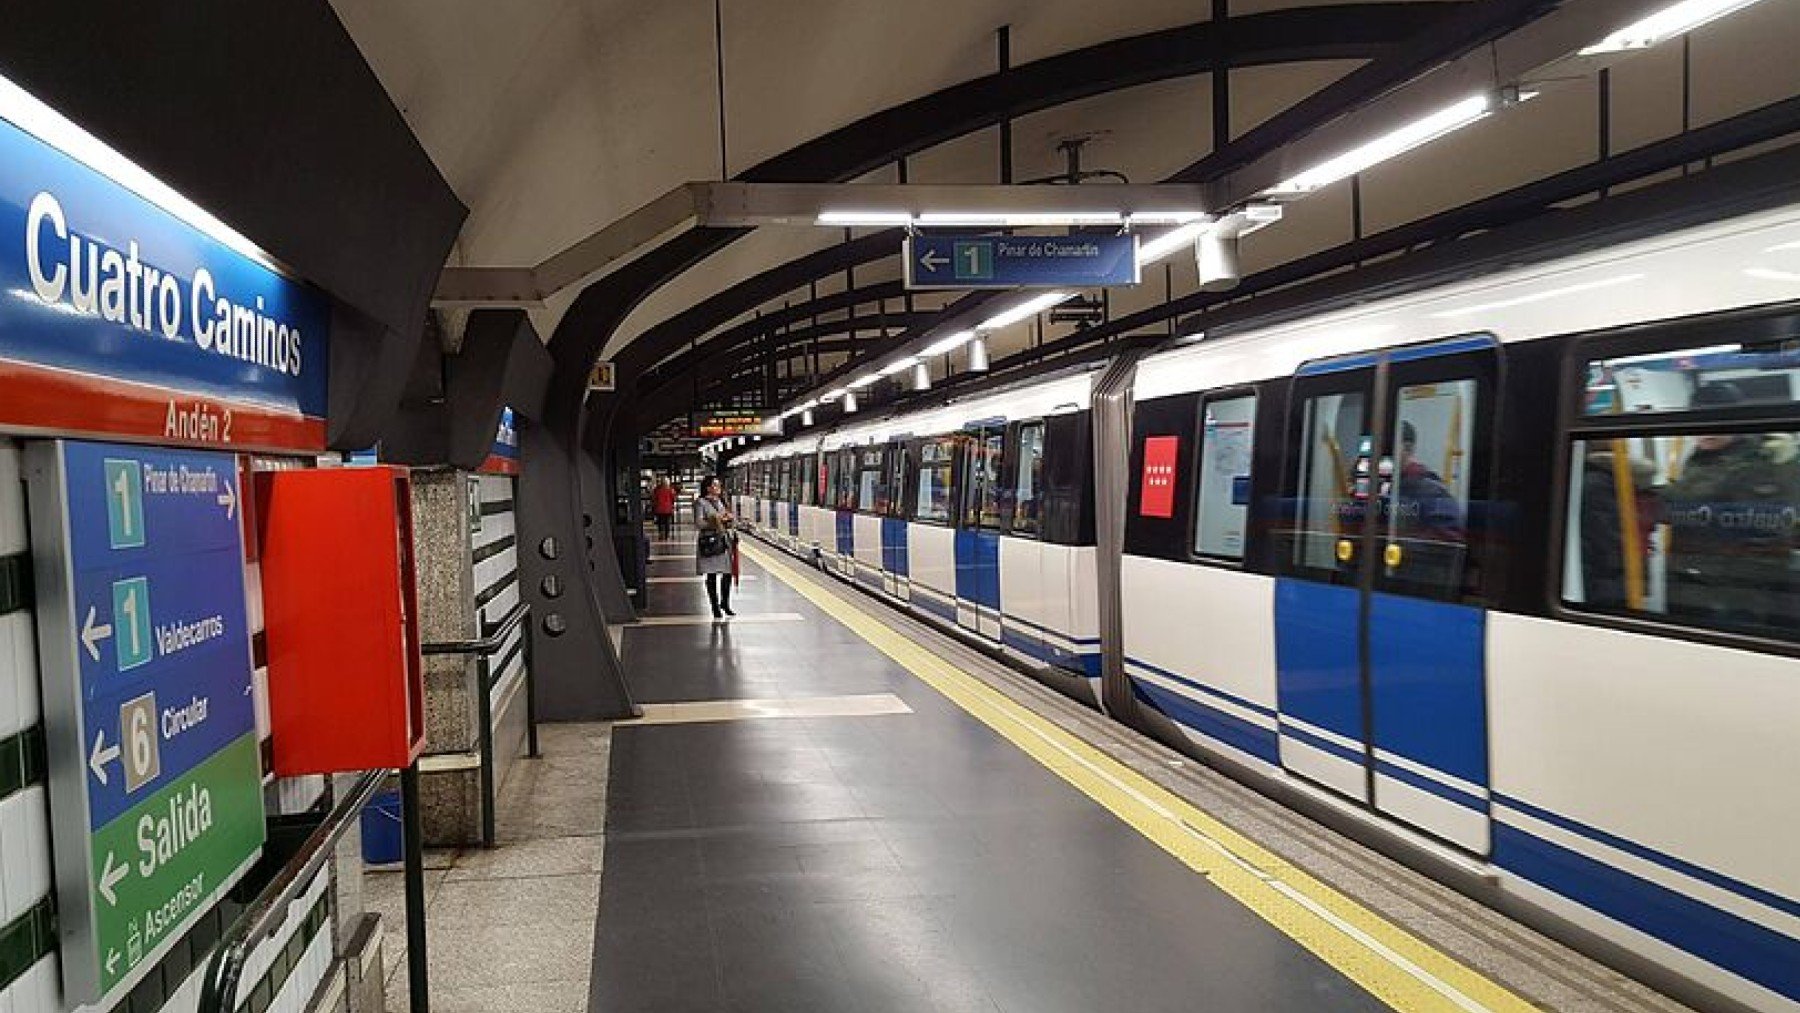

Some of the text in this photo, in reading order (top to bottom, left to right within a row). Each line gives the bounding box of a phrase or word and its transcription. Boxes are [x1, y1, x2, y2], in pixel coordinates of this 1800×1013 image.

[964, 246, 979, 275] 1
[998, 242, 1027, 257] Pinar
[1028, 242, 1042, 257] de
[26, 191, 302, 377] Cuatro Caminos
[164, 400, 233, 443] Andén 2
[114, 469, 132, 537] 1
[143, 463, 168, 493] Pinar
[168, 464, 180, 493] de
[123, 588, 140, 656] 1
[155, 614, 223, 657] Valdecarros
[131, 706, 150, 777] 6
[161, 695, 208, 740] Circular
[137, 782, 212, 878] Salida
[145, 872, 204, 946] Ascensor
